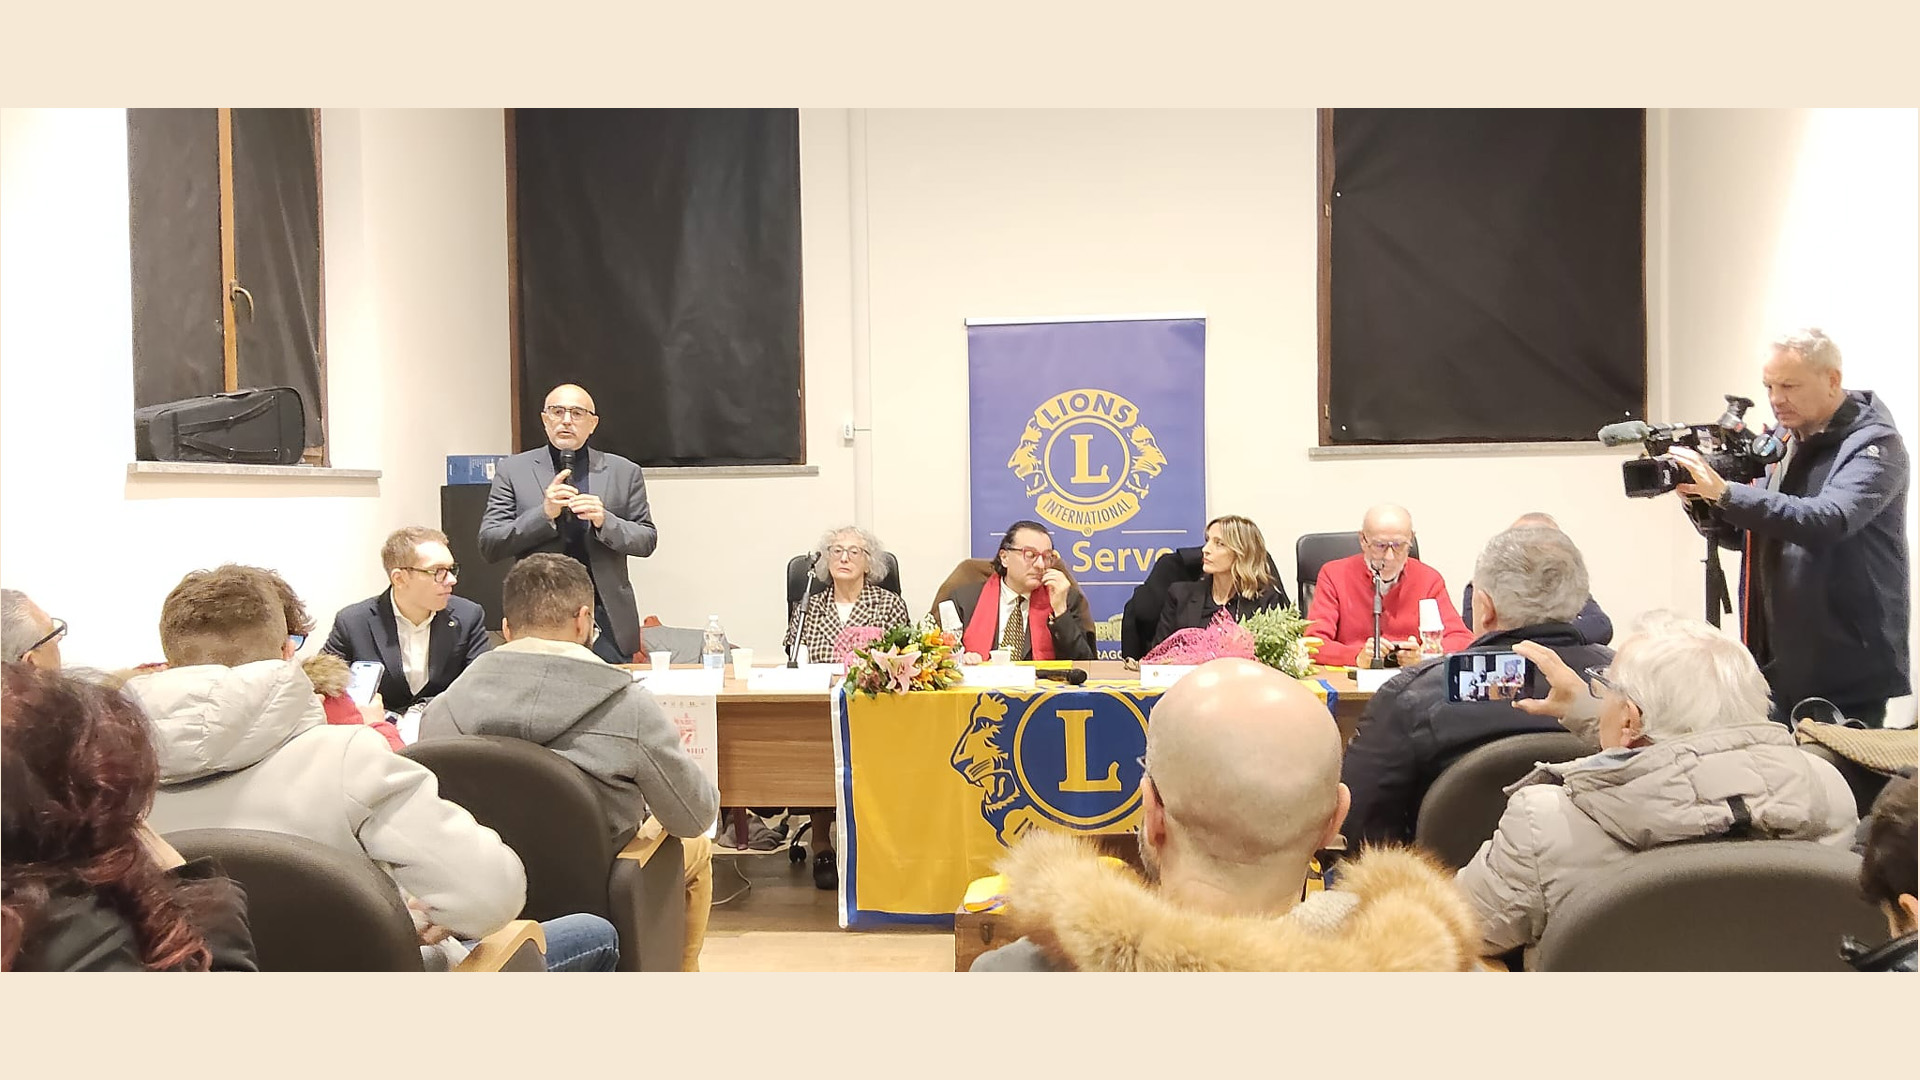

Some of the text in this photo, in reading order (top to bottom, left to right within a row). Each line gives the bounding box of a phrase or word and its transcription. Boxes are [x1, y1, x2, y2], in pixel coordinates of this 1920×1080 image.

[1041, 393, 1133, 425] LIONS
[1069, 434, 1110, 483] L
[1043, 498, 1133, 526] INTERNATIONAL
[1055, 709, 1122, 792] L
